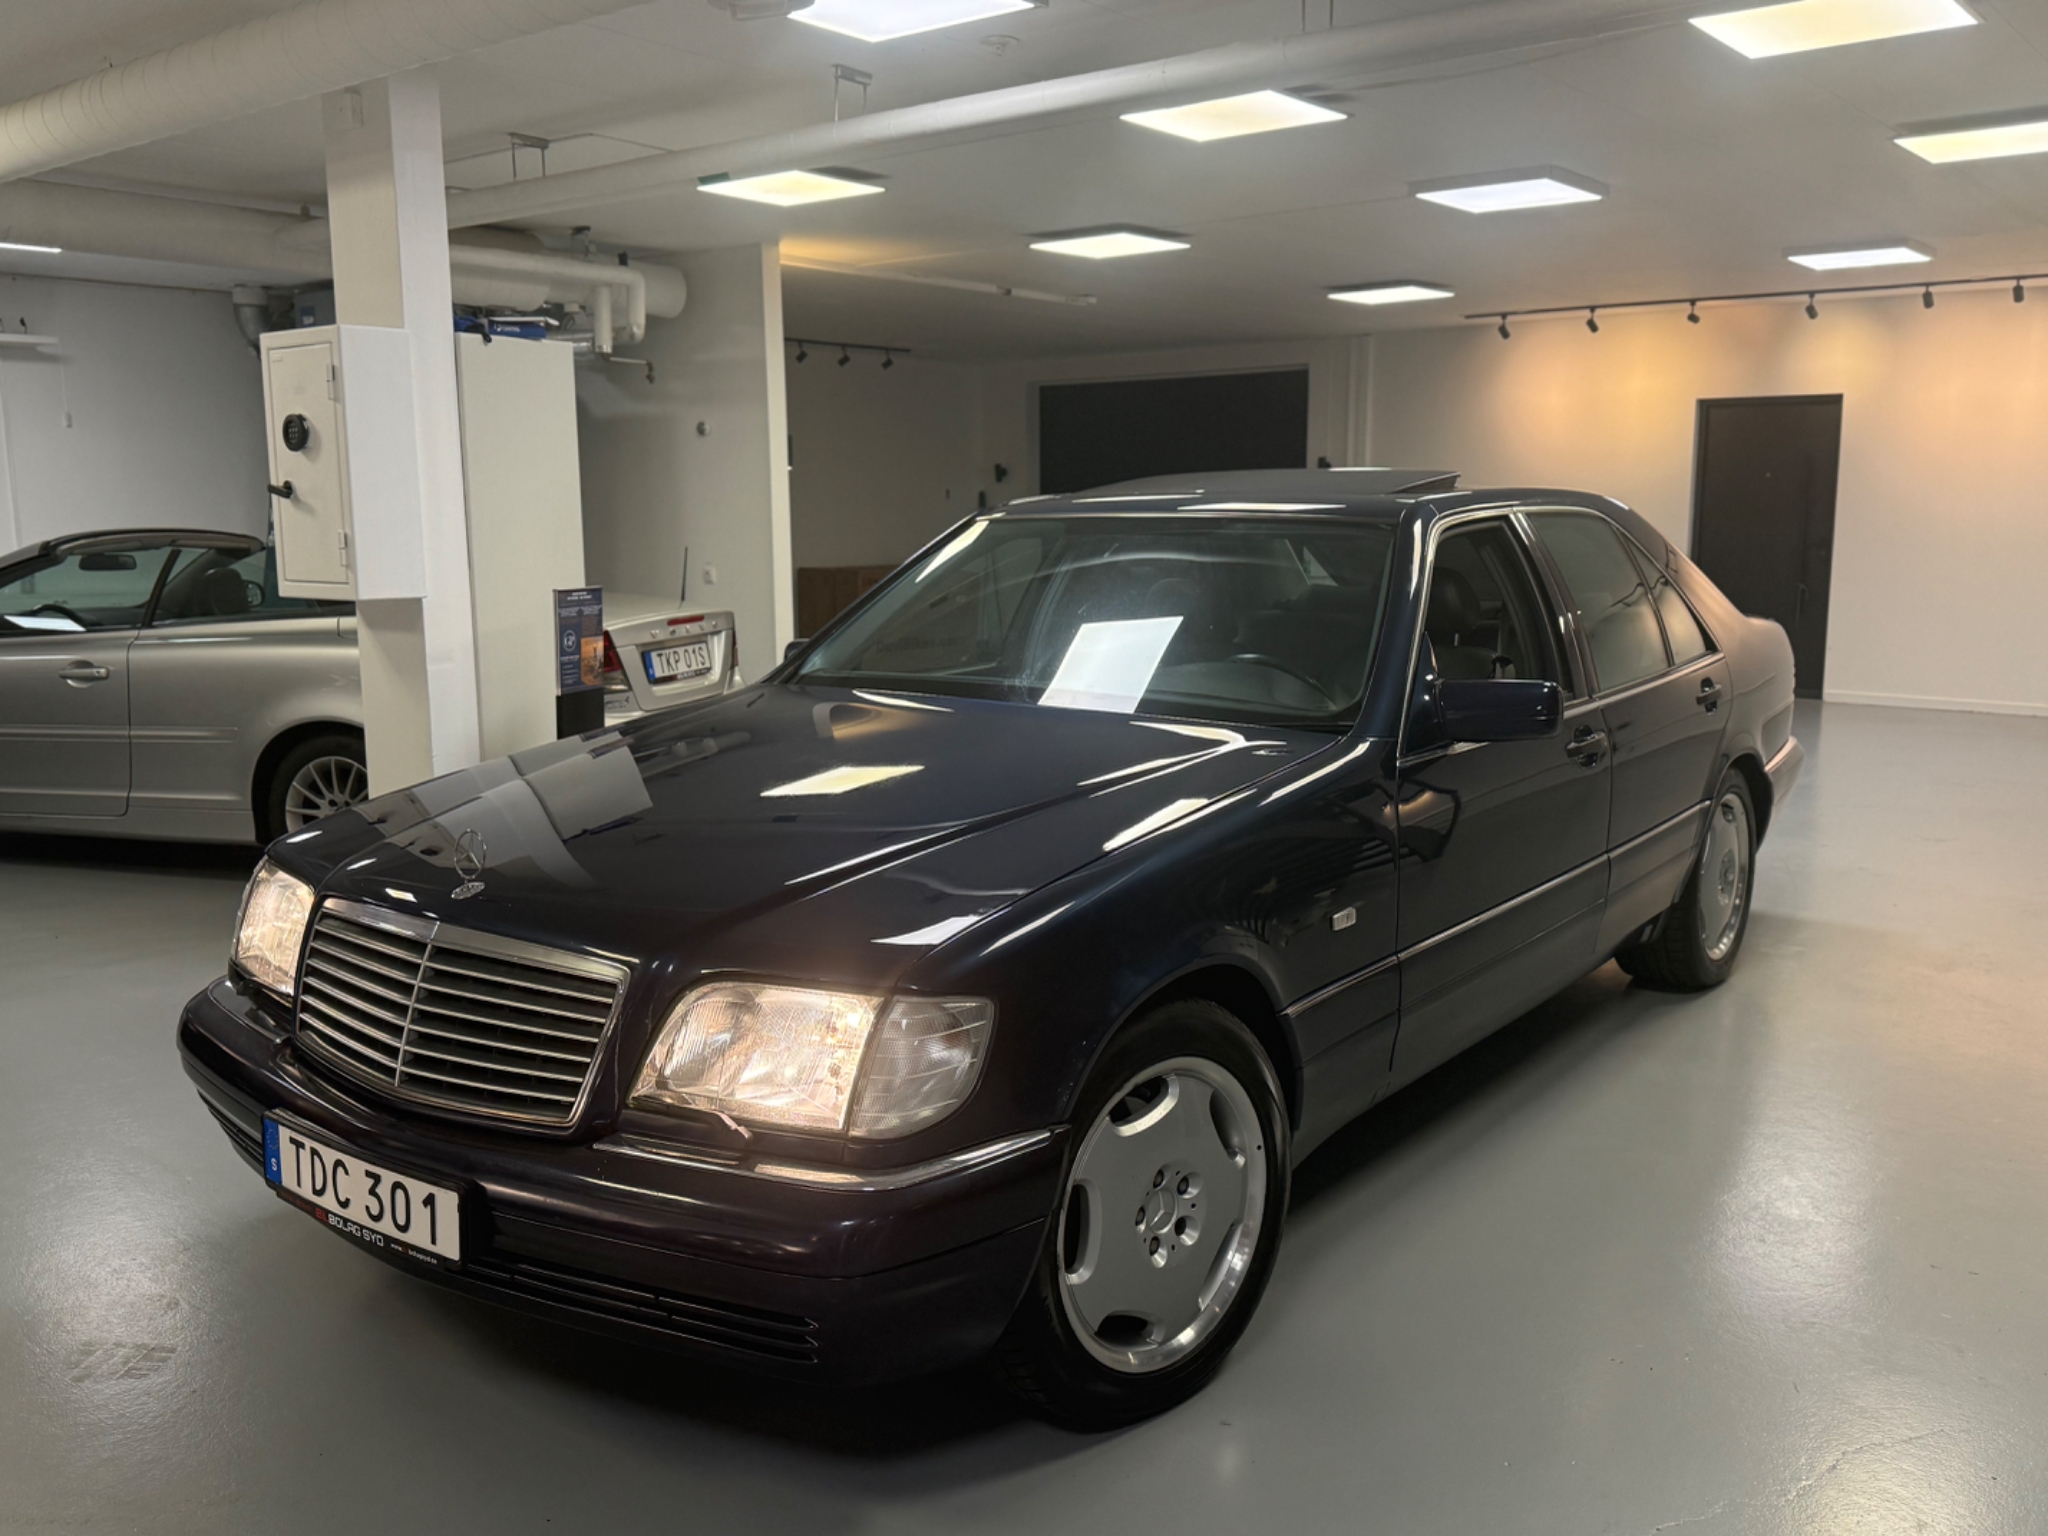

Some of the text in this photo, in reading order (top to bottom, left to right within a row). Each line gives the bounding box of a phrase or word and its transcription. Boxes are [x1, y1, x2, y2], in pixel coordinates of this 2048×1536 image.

[656, 650, 680, 674] TKP
[271, 1158, 277, 1171] S
[289, 1136, 437, 1247] TDC 301
[362, 1229, 384, 1247] SYD
